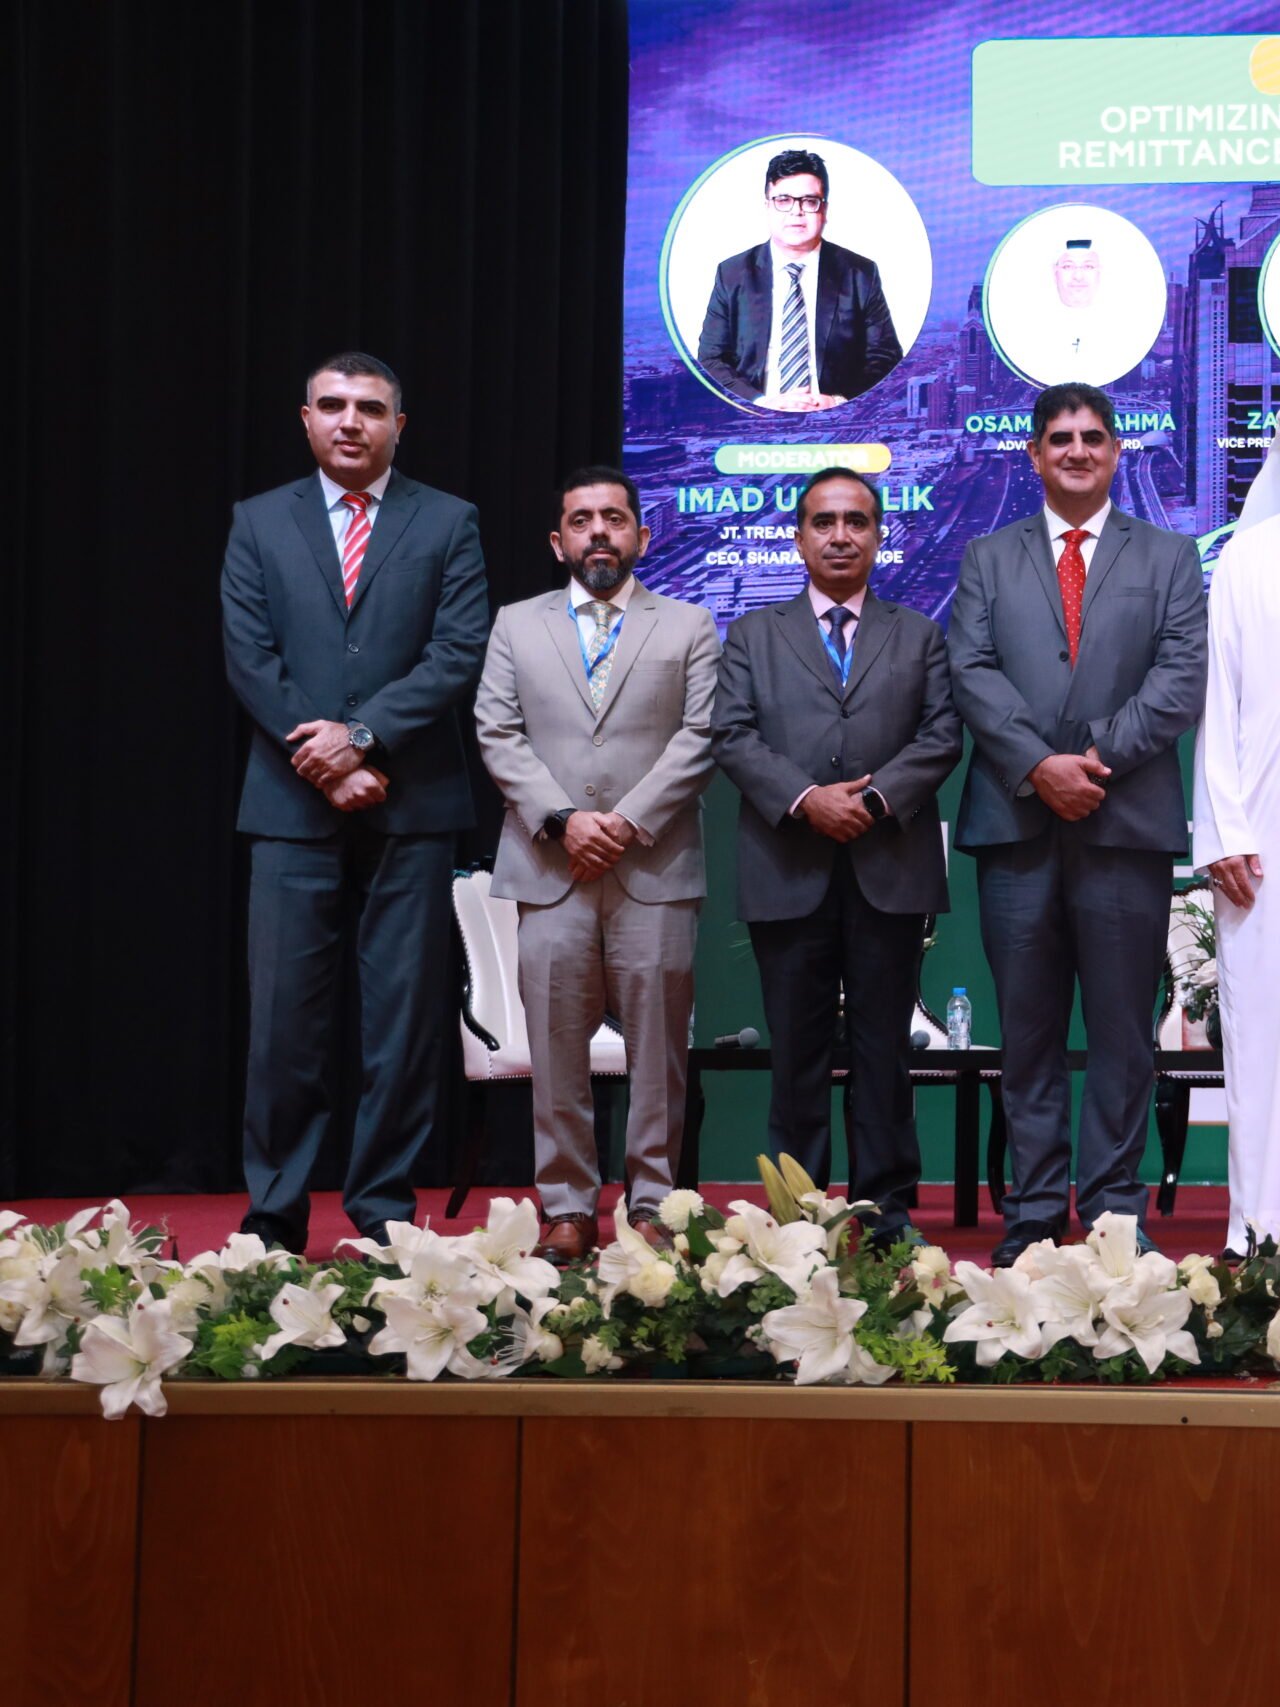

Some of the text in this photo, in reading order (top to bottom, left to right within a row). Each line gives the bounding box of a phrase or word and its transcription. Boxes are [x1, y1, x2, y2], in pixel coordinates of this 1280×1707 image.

[966, 413, 1176, 433] OSAM AHMA
[1216, 437, 1245, 448] VICE
[738, 450, 868, 468] MODERATOR
[679, 487, 764, 512] IMAD
[882, 485, 934, 511] LIK
[720, 526, 741, 539] JT.
[706, 551, 805, 567] CEO, SHARA
